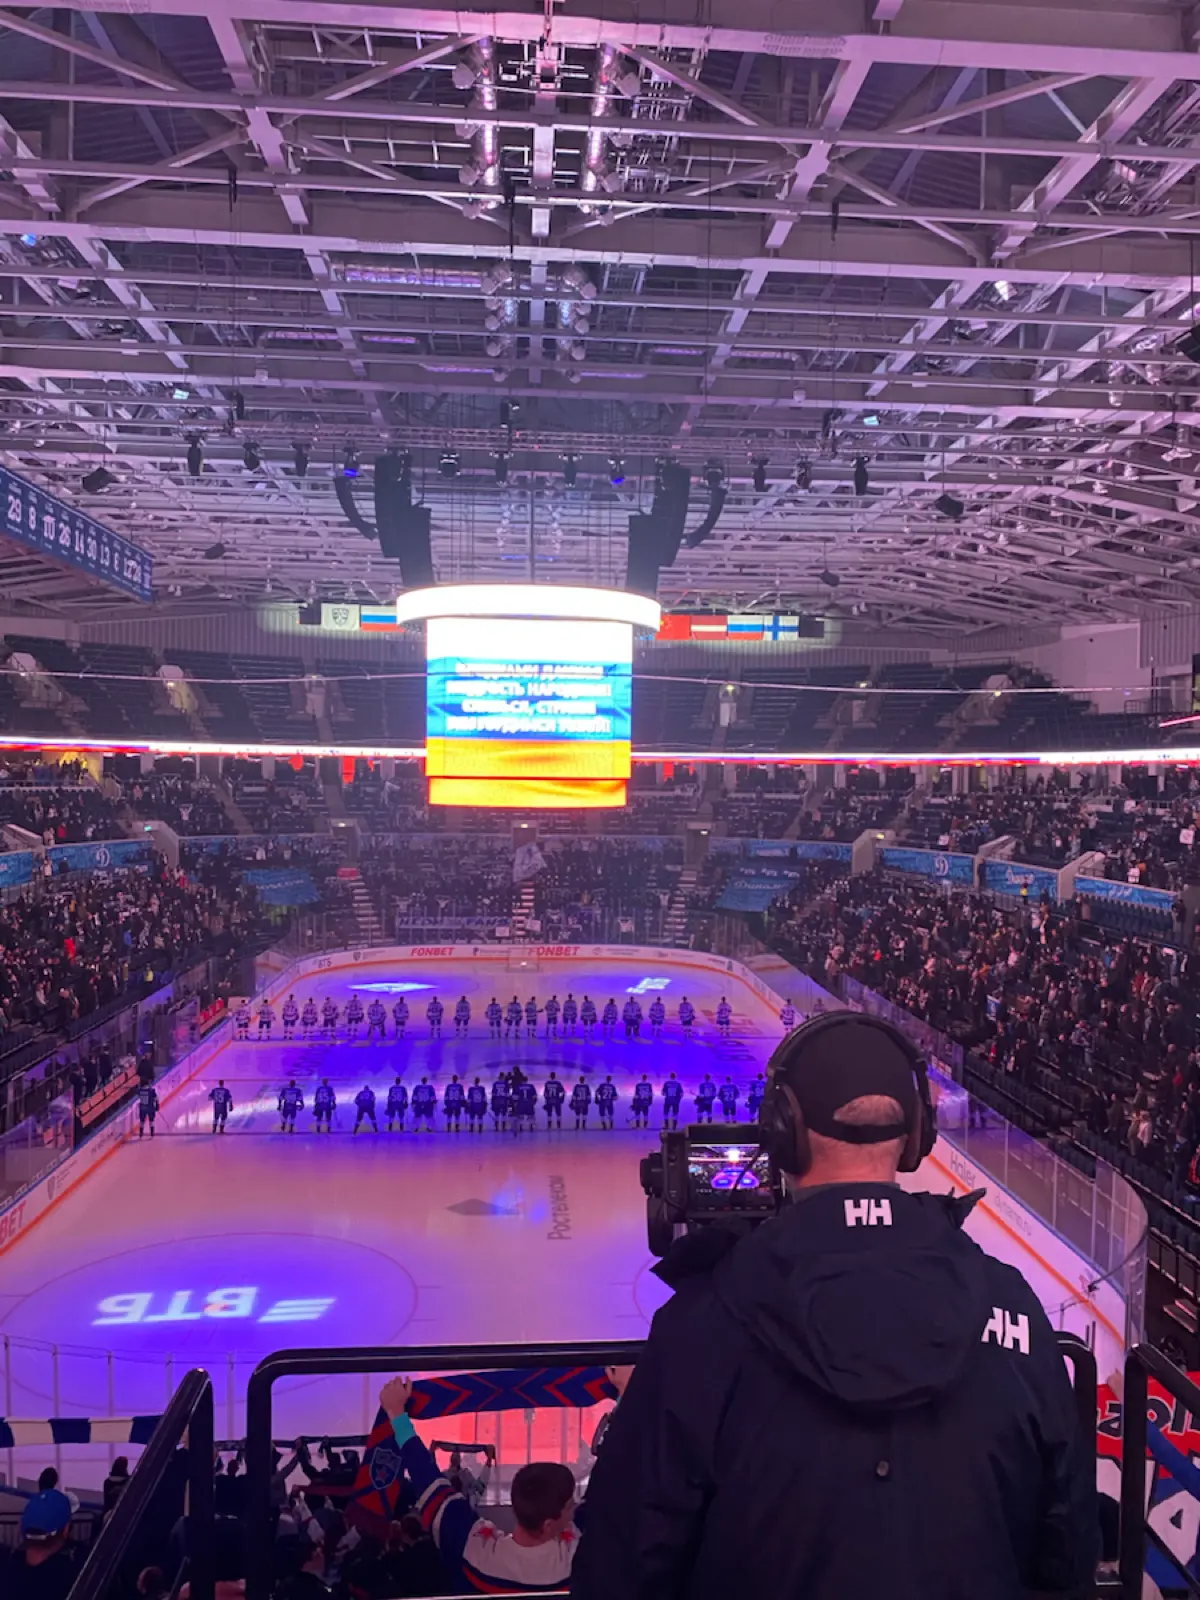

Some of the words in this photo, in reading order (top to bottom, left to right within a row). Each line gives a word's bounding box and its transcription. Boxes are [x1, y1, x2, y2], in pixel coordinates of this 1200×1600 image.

[7, 495, 22, 522] 29
[410, 946, 455, 957] FONBET
[528, 946, 580, 957] FONBET
[844, 1198, 893, 1227] HH
[92, 1286, 259, 1325] ВТБ
